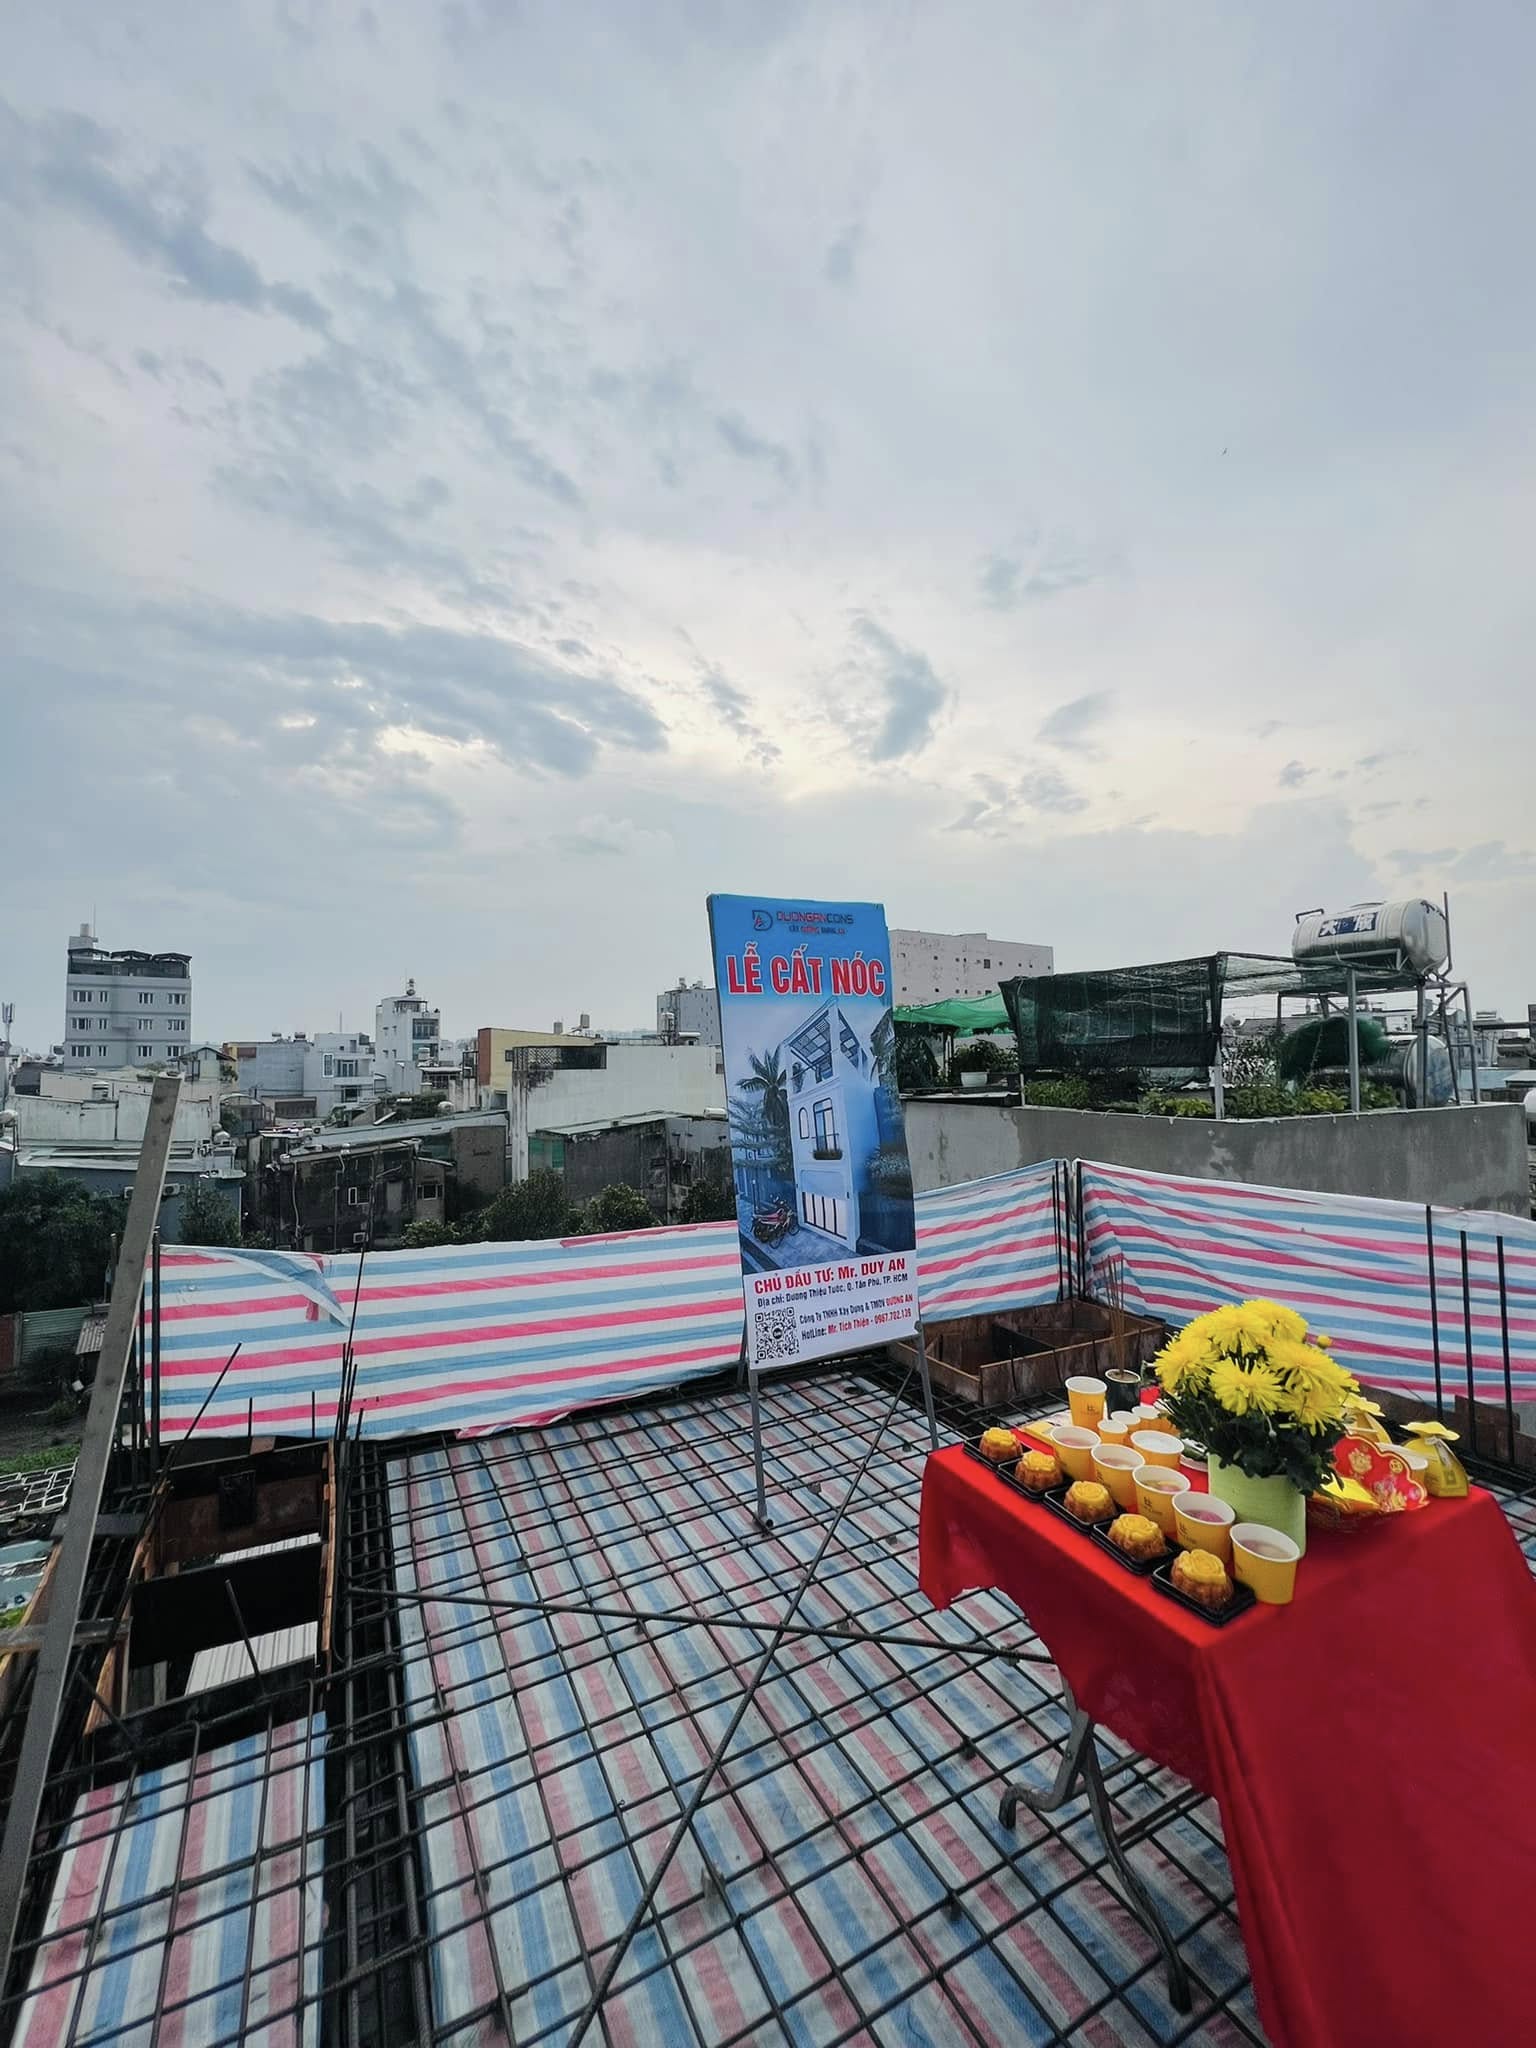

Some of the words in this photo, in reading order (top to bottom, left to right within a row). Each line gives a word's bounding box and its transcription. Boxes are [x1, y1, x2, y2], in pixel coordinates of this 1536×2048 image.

[726, 941, 763, 994] LỄ
[770, 944, 823, 996] CẤT
[831, 951, 885, 996] NÓC
[754, 1273, 782, 1294] CHỦ
[785, 1268, 812, 1289] ĐẦU
[814, 1267, 835, 1283] TƯ:
[838, 1266, 858, 1280] Mr.
[861, 1260, 884, 1276] DUY
[888, 1258, 905, 1272] AN
[893, 1273, 908, 1282] HCM
